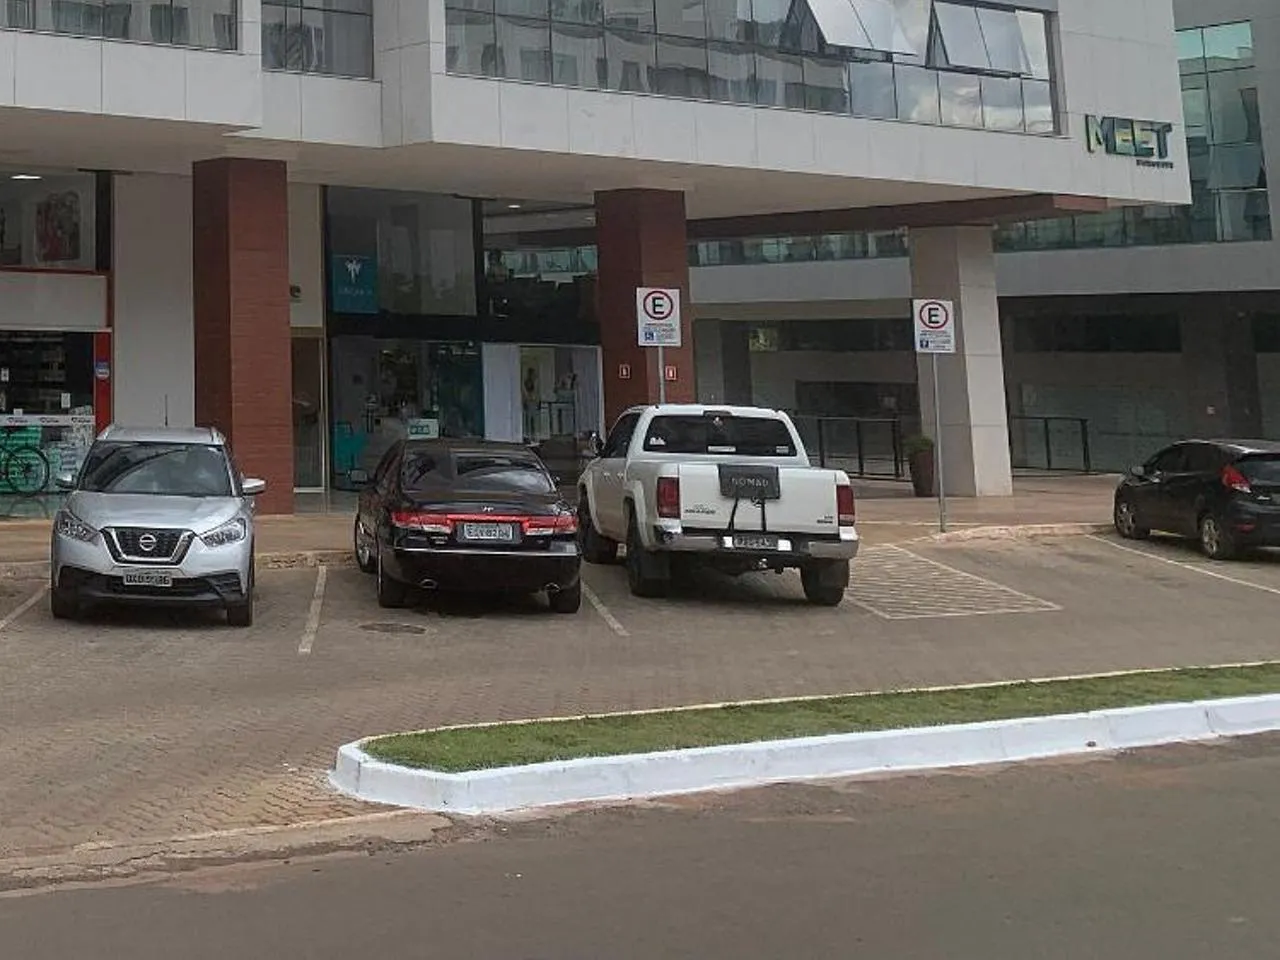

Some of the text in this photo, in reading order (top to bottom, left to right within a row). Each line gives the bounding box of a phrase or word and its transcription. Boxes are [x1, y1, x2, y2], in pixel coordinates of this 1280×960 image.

[1085, 114, 1172, 159] MEET
[651, 296, 665, 315] E
[928, 307, 940, 324] E
